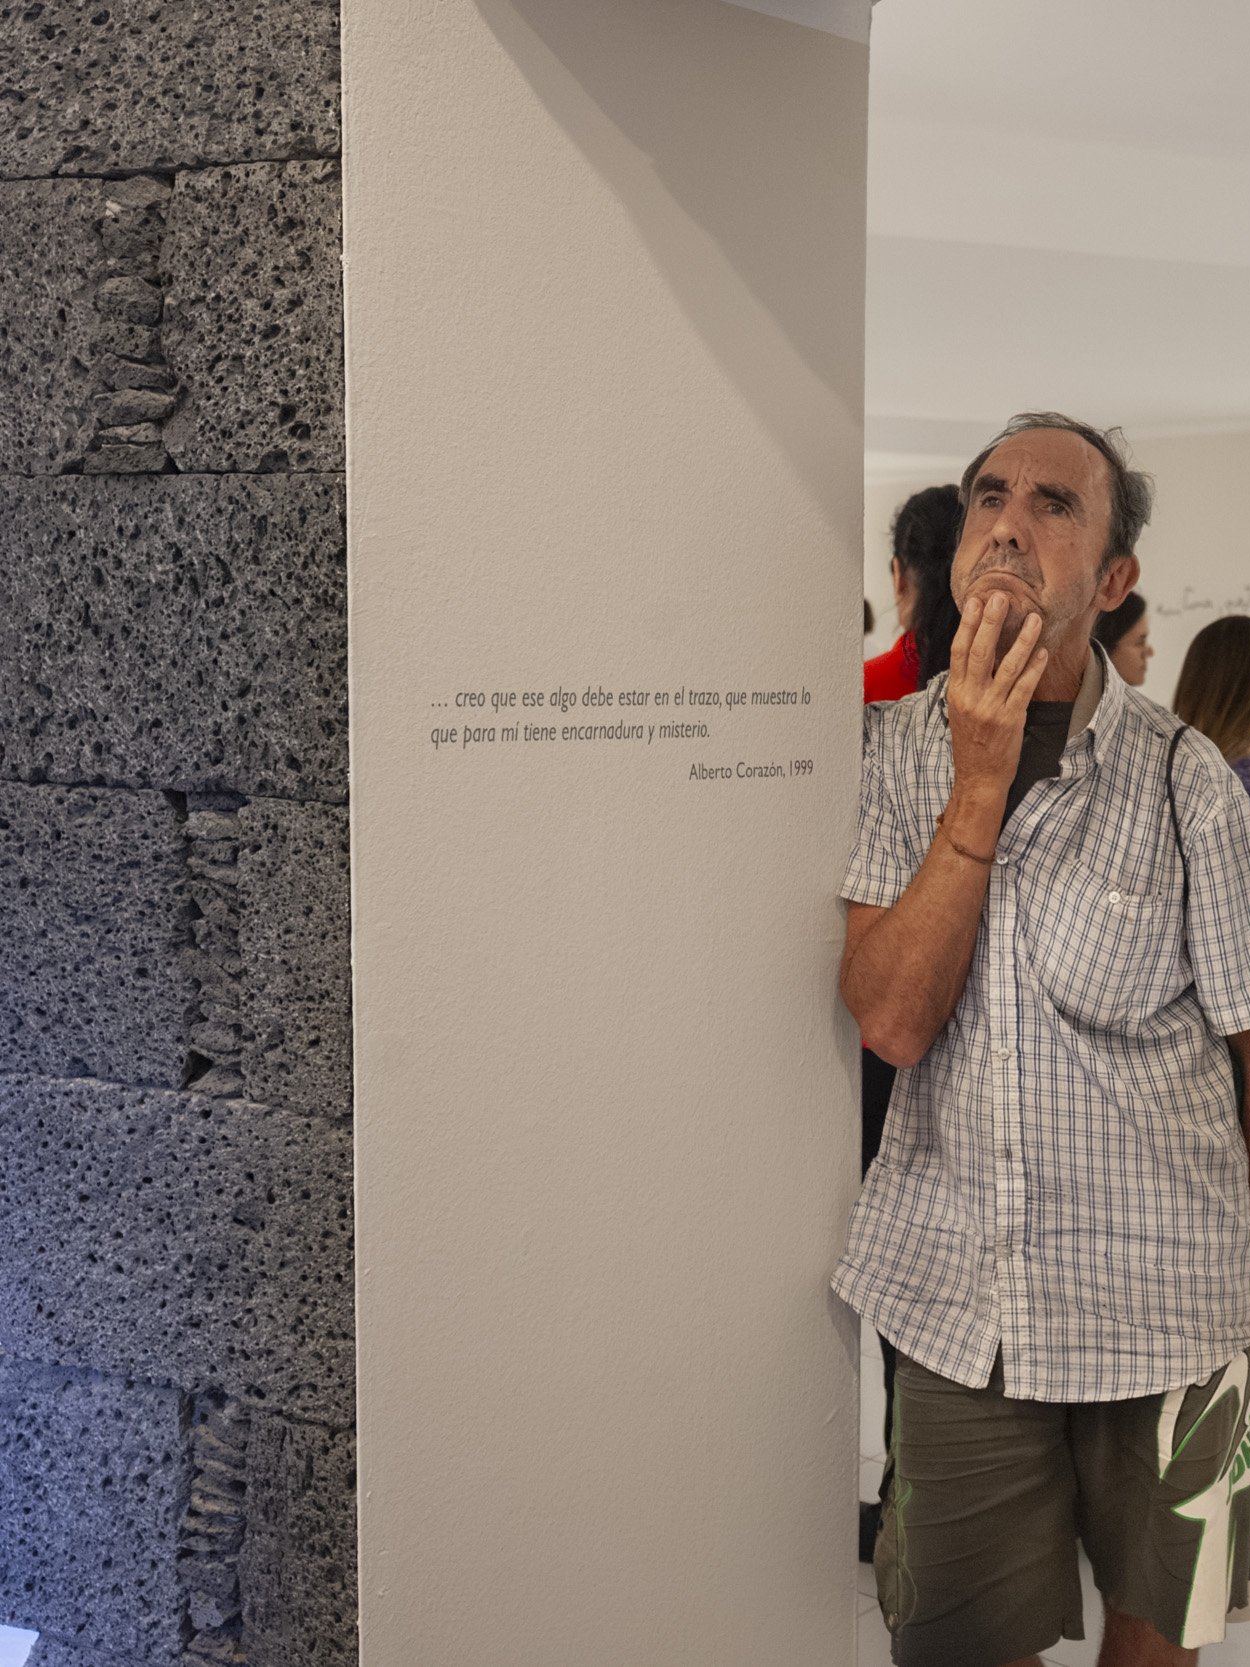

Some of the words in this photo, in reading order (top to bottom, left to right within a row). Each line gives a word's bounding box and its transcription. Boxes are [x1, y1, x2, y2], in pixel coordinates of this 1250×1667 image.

[455, 691, 486, 708] creo
[490, 691, 517, 714] que
[521, 691, 545, 708] ese
[549, 685, 578, 714] algo
[582, 685, 614, 707] debe
[618, 688, 651, 707] estar
[654, 691, 670, 707] en
[674, 685, 686, 707] el
[688, 687, 724, 711] trazo,
[725, 691, 748, 712] que
[751, 687, 798, 706] muestra
[800, 685, 812, 706] lo
[430, 727, 458, 751] que
[463, 723, 496, 750] para
[501, 720, 521, 743] mí
[523, 722, 558, 743] tiene
[561, 719, 645, 742] encarnadura
[647, 725, 656, 746] y
[658, 720, 711, 740] misterio.
[688, 762, 733, 781] Alberto
[736, 760, 787, 779] Corazón,
[789, 758, 814, 777] 1999
